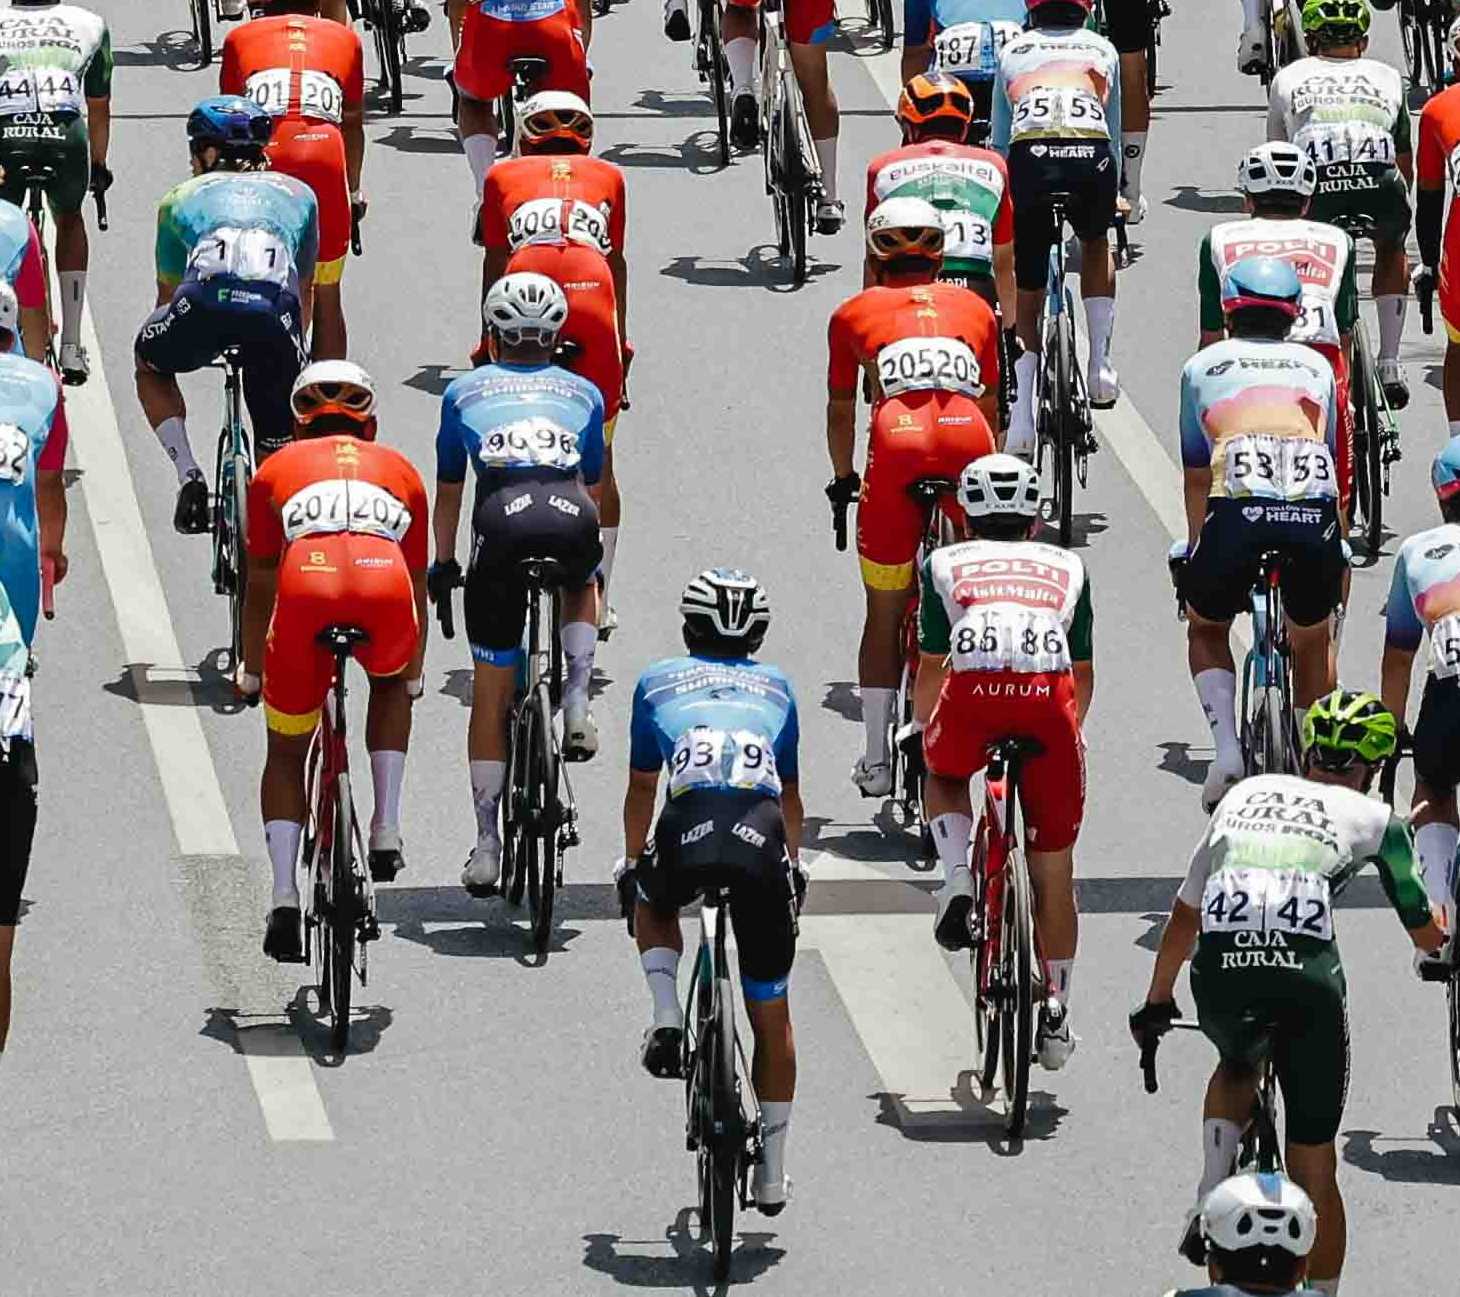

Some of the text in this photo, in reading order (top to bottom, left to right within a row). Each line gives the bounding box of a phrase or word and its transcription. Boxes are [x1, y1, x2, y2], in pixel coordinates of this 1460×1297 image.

[39, 76, 74, 98] 44
[13, 114, 53, 126] CAJA
[1016, 97, 1103, 123] 55 55
[3, 126, 65, 139] RURAL
[1048, 149, 1095, 158] HEART
[1356, 138, 1391, 160] 41
[1327, 165, 1367, 178] CAJA
[1319, 177, 1379, 191] RURAL
[883, 350, 935, 386] 205
[1233, 452, 1271, 479] 53
[289, 497, 403, 529] 207 207
[549, 496, 580, 516] LAZER
[1267, 512, 1322, 522] HEART
[961, 558, 1060, 580] POLTI
[1021, 626, 1063, 652] 86
[973, 685, 1049, 696] AURUM
[675, 743, 712, 774] 93
[733, 824, 766, 846] LAZER
[1207, 891, 1324, 931] 42 42
[1234, 932, 1287, 946] CAJA
[1221, 951, 1303, 969] RURAL
